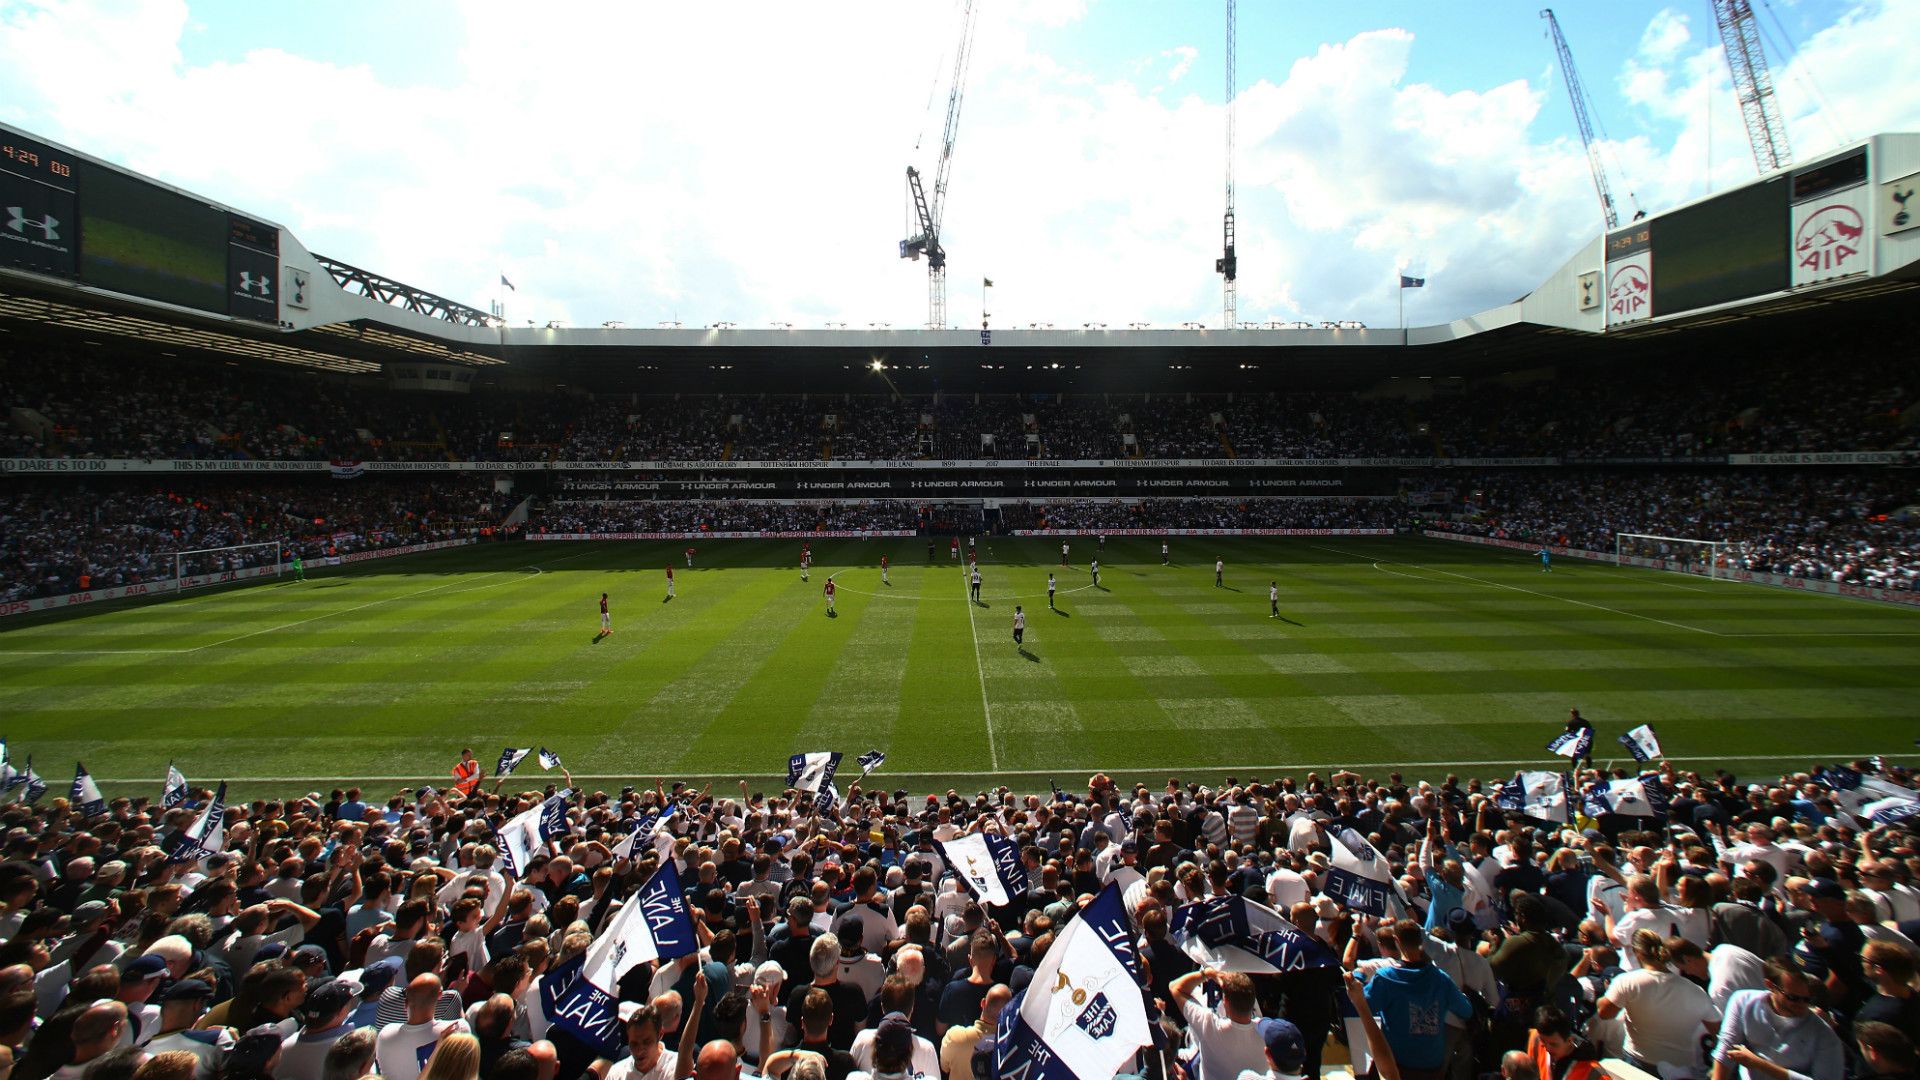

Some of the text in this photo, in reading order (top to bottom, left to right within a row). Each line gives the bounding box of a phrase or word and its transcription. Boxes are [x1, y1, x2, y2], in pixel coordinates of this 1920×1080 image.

[50, 159, 72, 178] 00
[1799, 244, 1858, 272] AIA
[1611, 295, 1646, 315] AIA
[0, 459, 107, 471] TO DARE IS TO DO
[941, 460, 956, 468] 1899
[1750, 454, 1767, 464] THE
[173, 461, 193, 471] THIS
[195, 461, 203, 471] IS
[204, 461, 219, 471] MY
[272, 462, 288, 470] AND
[369, 462, 414, 470] TOTTENHAM
[475, 462, 486, 470] TO
[486, 462, 508, 470] DARE
[125, 583, 148, 596] AIA
[68, 592, 93, 605] AIA
